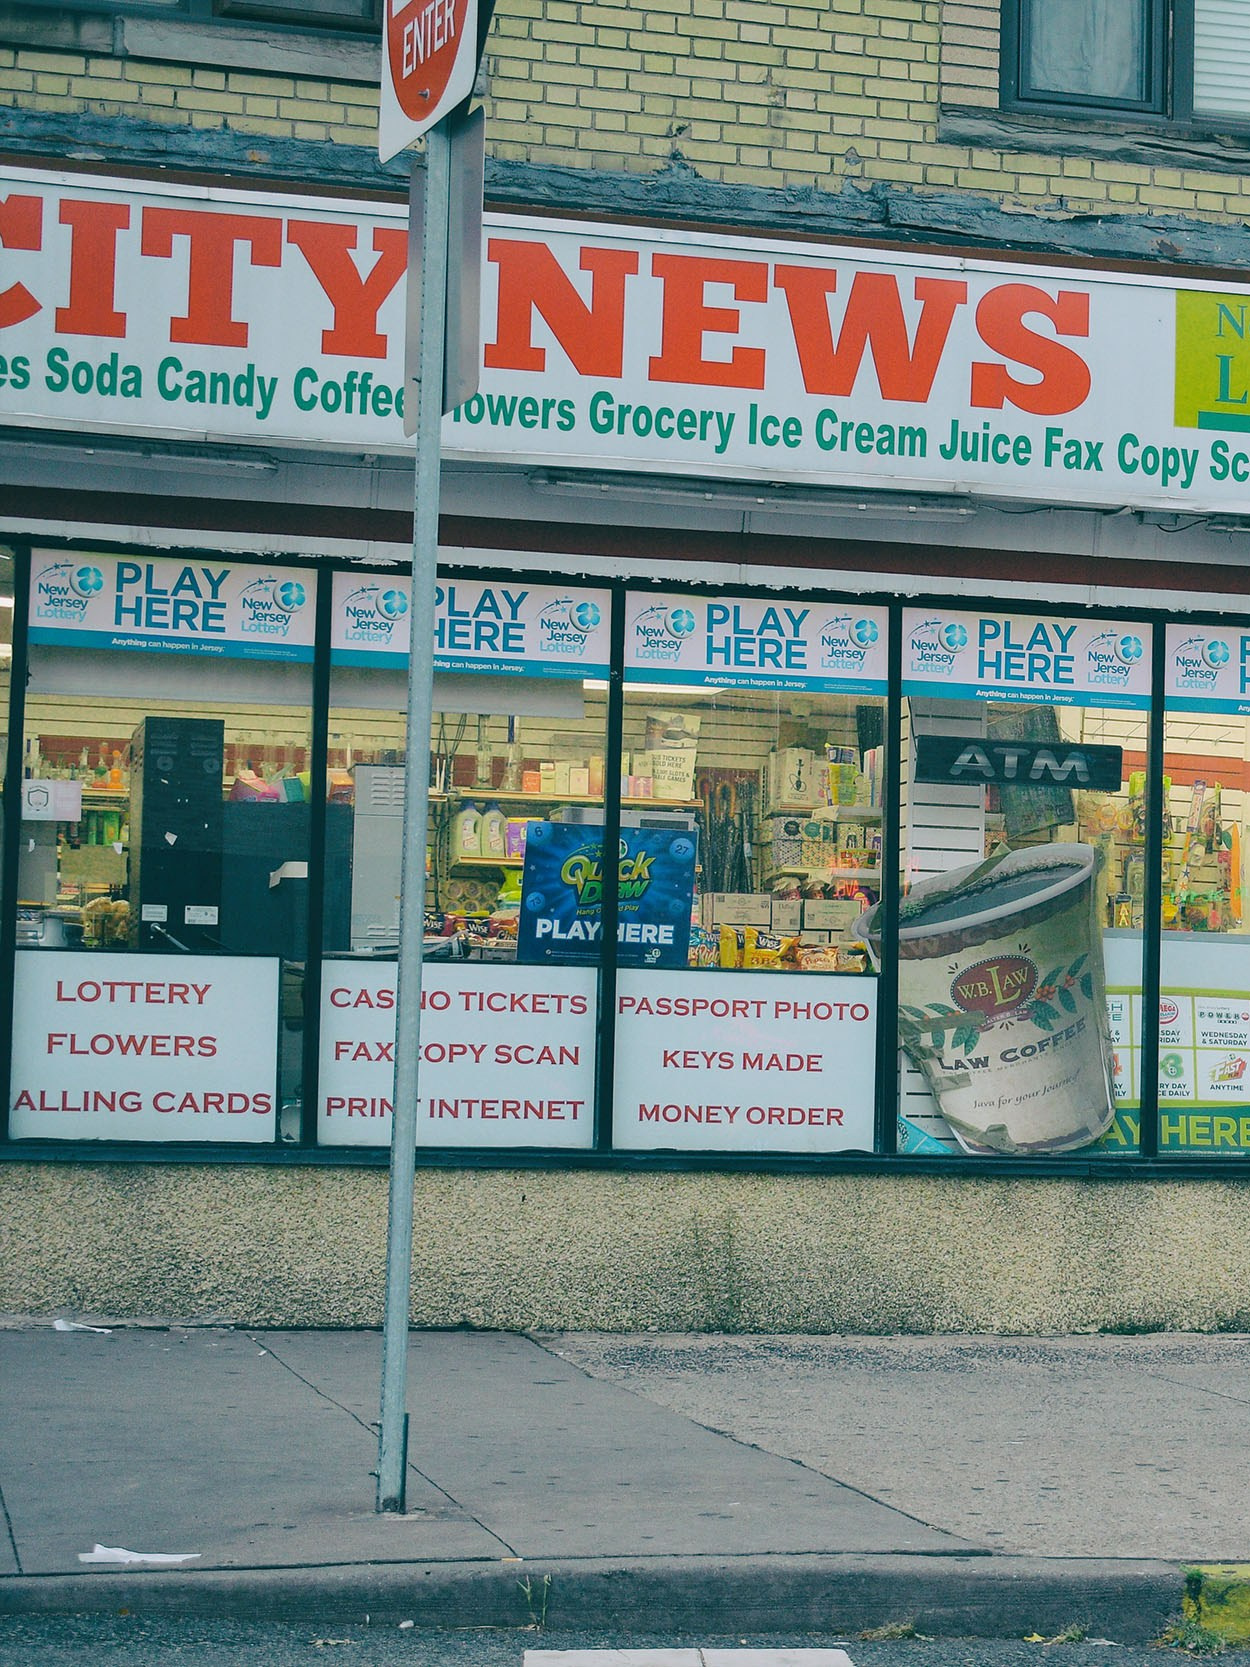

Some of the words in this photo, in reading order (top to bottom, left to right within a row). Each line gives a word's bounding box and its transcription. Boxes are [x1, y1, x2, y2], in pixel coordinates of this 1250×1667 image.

[402, 0, 456, 79] ENTER
[484, 238, 1092, 416] NEWS
[45, 347, 143, 399] Soda
[157, 356, 279, 420] Candy
[589, 391, 736, 454] Grocery
[748, 403, 803, 449] Ice
[815, 408, 927, 458] Cream
[939, 419, 1032, 466] Juice
[1044, 427, 1104, 472] Fax
[1117, 432, 1199, 489] Copy
[116, 562, 231, 600] PLAY
[38, 583, 69, 595] New
[45, 595, 88, 610] Jersey
[242, 598, 272, 610] New
[114, 595, 227, 633] HERE
[249, 611, 291, 626] Jersey
[346, 606, 376, 619] New
[352, 619, 394, 633] Jersey
[541, 618, 570, 631] New
[707, 604, 811, 638] PLAY
[547, 631, 587, 646] Jersey
[636, 625, 664, 638] New
[979, 619, 1077, 653] PLAY
[642, 636, 682, 651] Jersey
[821, 635, 849, 648] New
[912, 639, 938, 651] New
[706, 635, 807, 670] HERE
[827, 647, 866, 661] Jersey
[917, 651, 955, 665] Jersey
[1088, 651, 1114, 663] New
[977, 650, 1075, 684] HERE
[1176, 656, 1202, 668] New
[1093, 663, 1130, 677] Jersey
[1182, 668, 1218, 681] Jersey
[950, 745, 1091, 782] ATM
[534, 826, 543, 837] 6
[674, 844, 689, 856] 27
[561, 851, 656, 895] QUCK
[535, 918, 602, 941] PLAY
[56, 981, 212, 1004] LOTTERY
[957, 981, 993, 999] W.B.
[986, 965, 1029, 1006] LAW
[330, 987, 451, 1011] CASO
[458, 991, 588, 1015] TICKETS
[618, 996, 767, 1018] PASSPORT
[774, 1001, 869, 1021] PHOTO
[1199, 1011, 1240, 1020] POWER
[1201, 1031, 1248, 1039] WEDNESDAY
[47, 1032, 217, 1057] FLOWERS
[937, 1056, 989, 1071] LAW
[1000, 1017, 1087, 1063] COFFEE
[334, 1041, 394, 1062] FAX
[417, 1042, 488, 1064] OPY
[494, 1045, 580, 1066] SCAN
[663, 1050, 734, 1070] KEYS
[742, 1052, 823, 1072] MADE
[1209, 1084, 1244, 1092] ANYTIME
[13, 1090, 143, 1113] ALLING
[152, 1091, 272, 1115] CARDS
[1015, 1091, 1040, 1106] your
[429, 1098, 584, 1120] INTERNET
[639, 1104, 740, 1124] MONEY
[746, 1107, 844, 1126] ORDER
